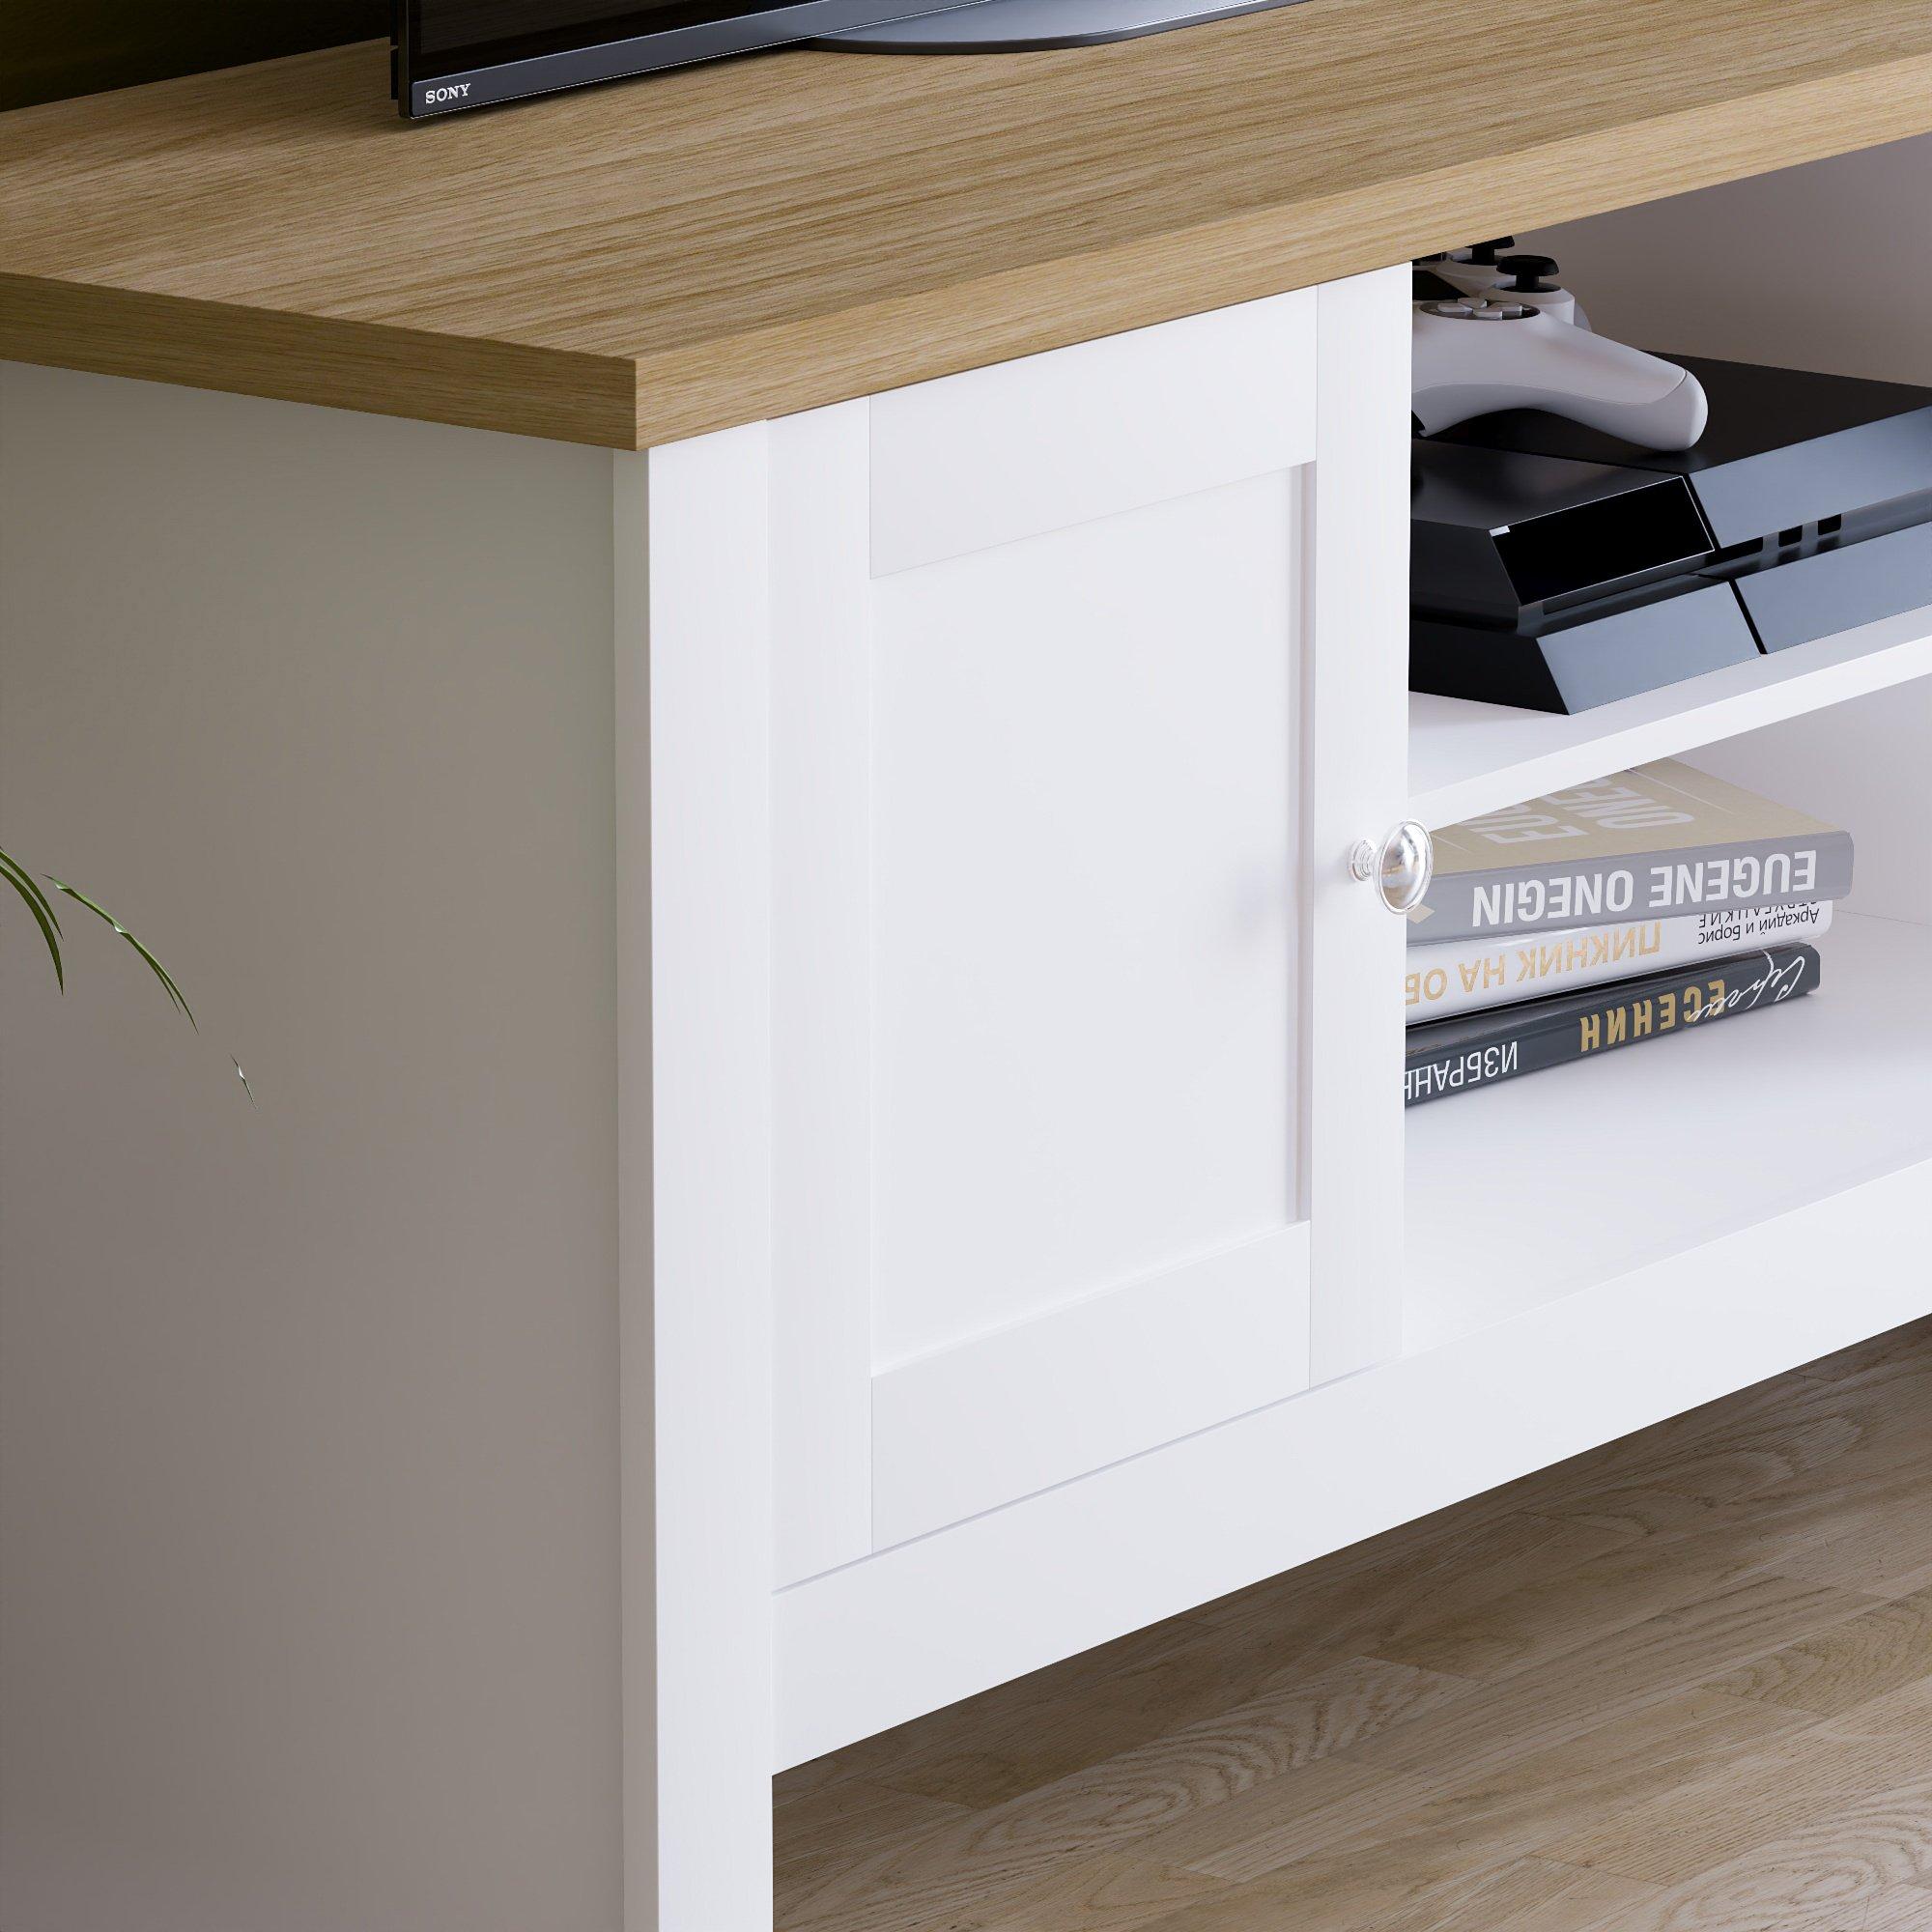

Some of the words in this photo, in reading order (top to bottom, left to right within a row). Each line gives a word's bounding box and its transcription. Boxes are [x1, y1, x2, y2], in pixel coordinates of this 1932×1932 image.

[425, 83, 470, 104] SONY
[1472, 869, 1634, 927] ONEGIN
[1648, 850, 1817, 908] EUGENE
[1697, 923, 1741, 945] Борис
[1745, 922, 1755, 934] и
[1758, 905, 1820, 935] Аркадий
[1517, 921, 1662, 981] ПИКНИК
[1458, 953, 1506, 993] НА
[1579, 979, 1726, 1053] ЕСЕНИН
